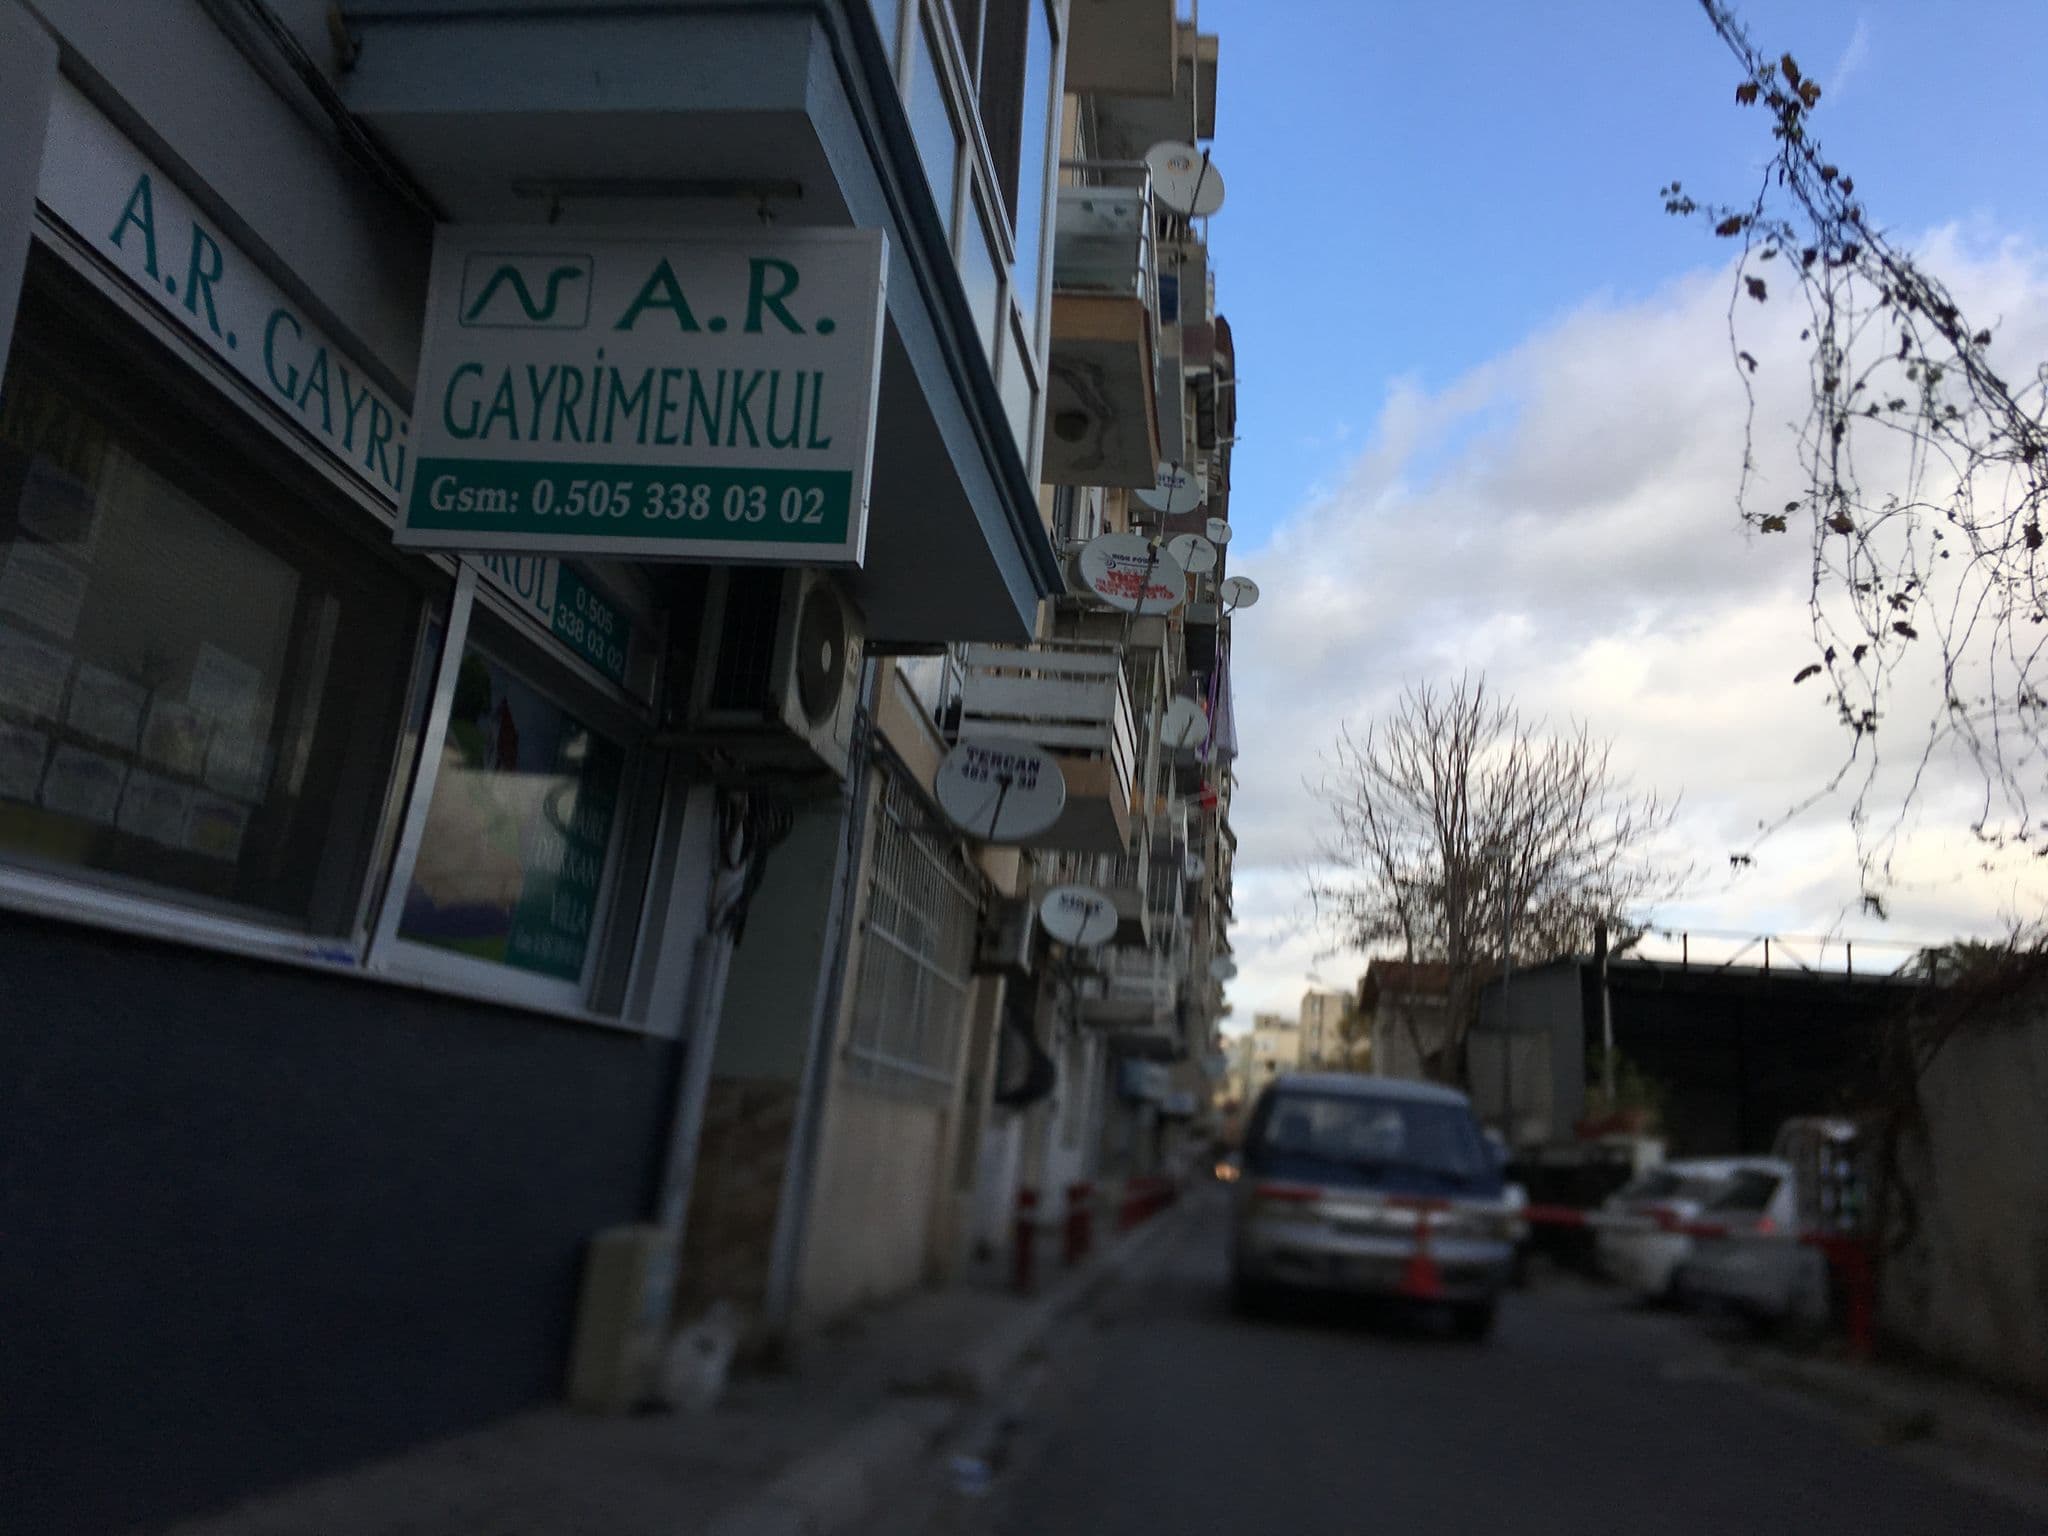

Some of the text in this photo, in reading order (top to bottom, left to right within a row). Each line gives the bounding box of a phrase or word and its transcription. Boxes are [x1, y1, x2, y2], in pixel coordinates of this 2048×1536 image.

[108, 173, 238, 350] A.R.
[612, 256, 836, 335] A.R.
[442, 346, 833, 450] GAYRİMENKUL
[428, 473, 825, 525] Gsm: 0.505 338 03 02
[557, 601, 585, 643] 338
[575, 586, 614, 634] 0.505
